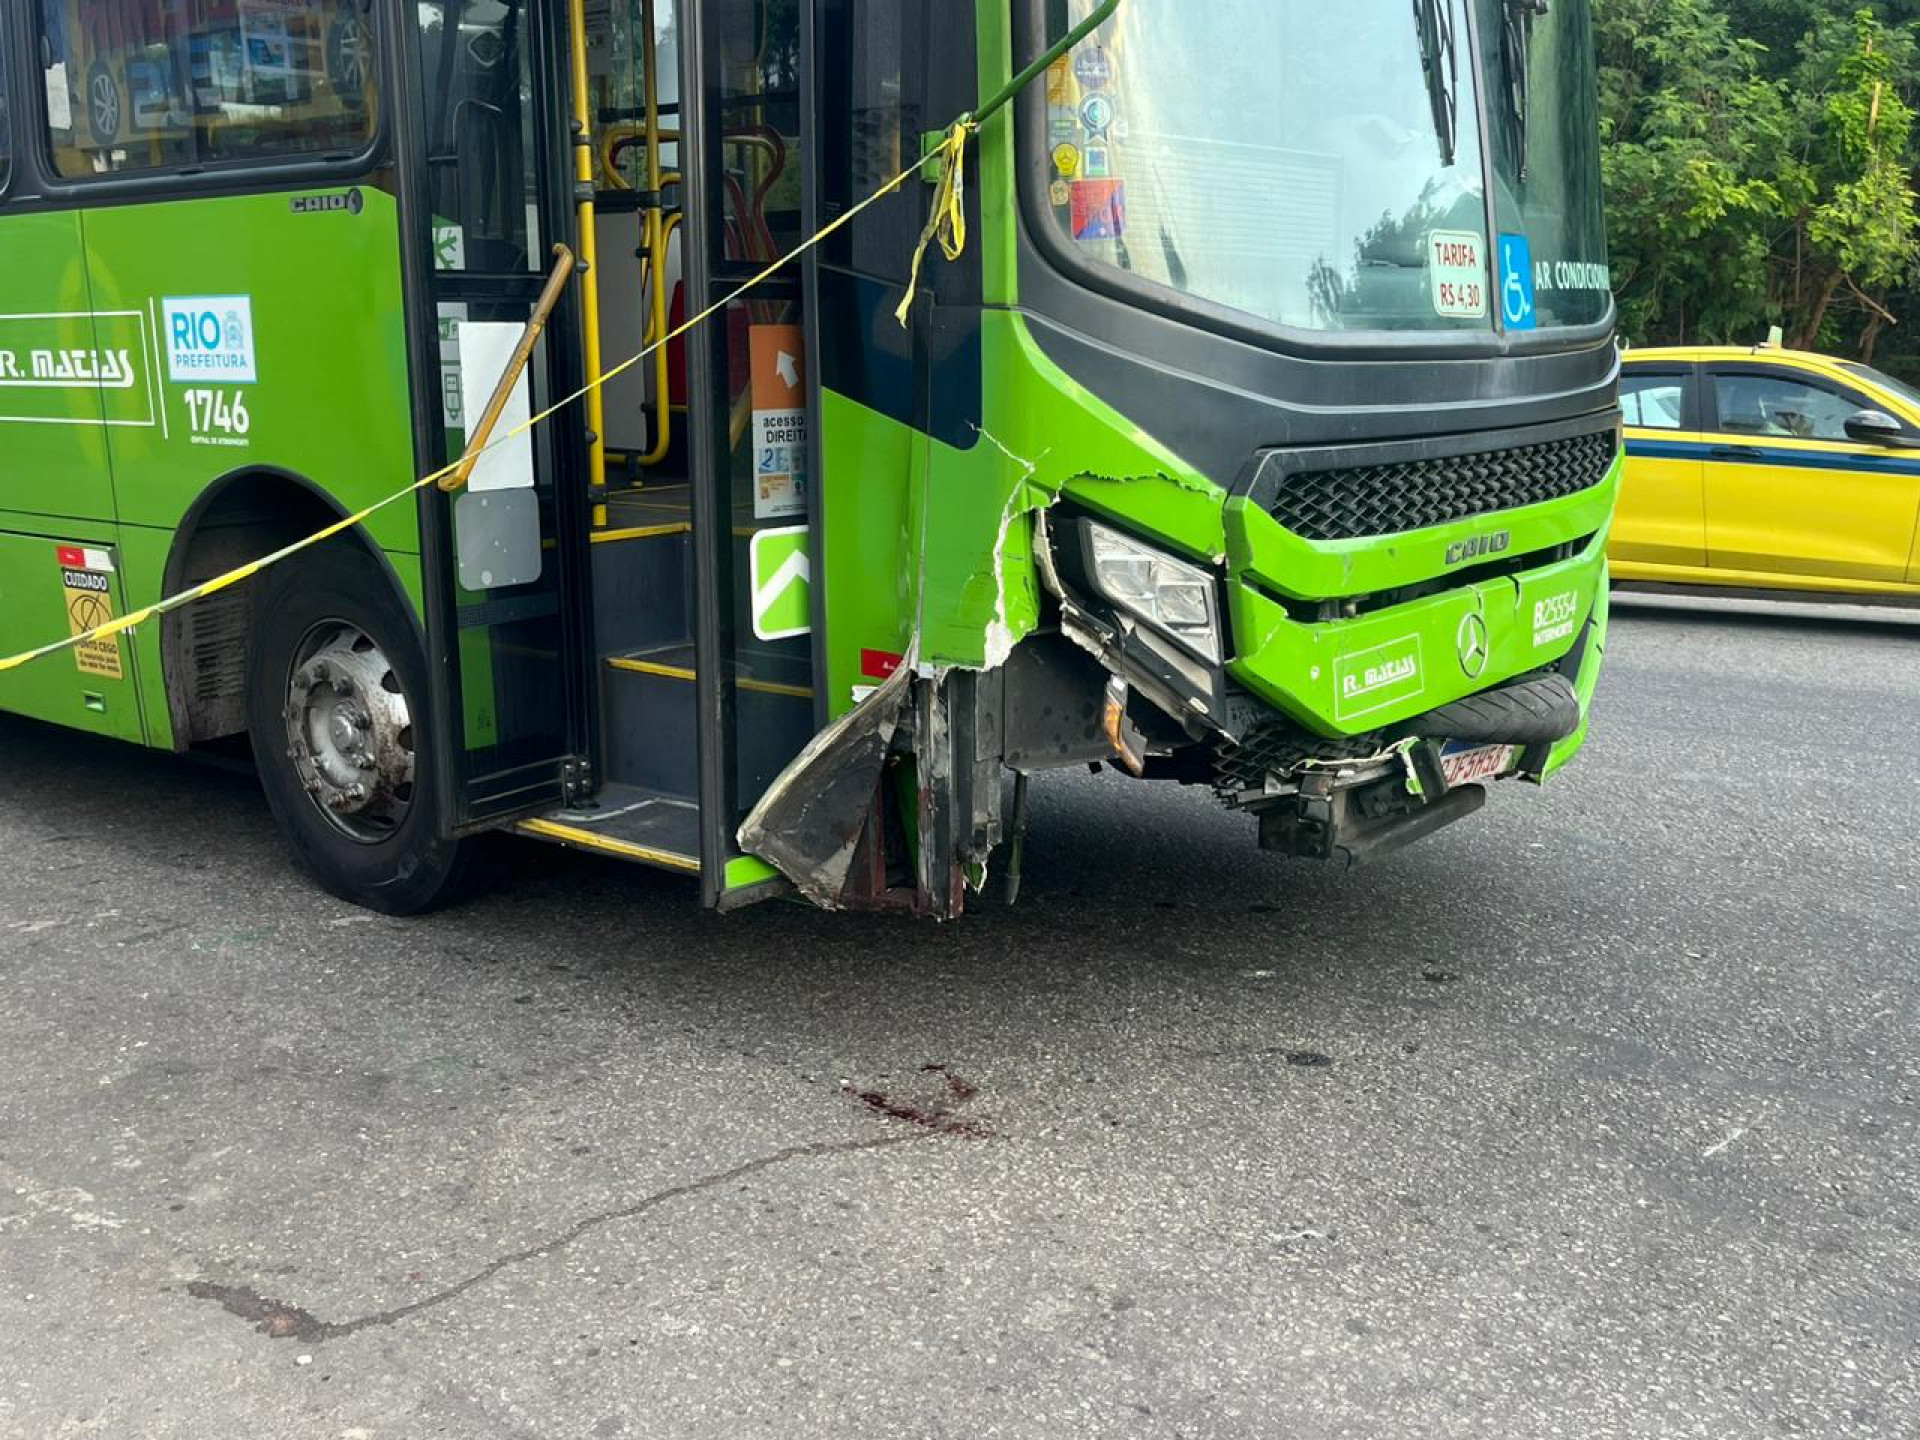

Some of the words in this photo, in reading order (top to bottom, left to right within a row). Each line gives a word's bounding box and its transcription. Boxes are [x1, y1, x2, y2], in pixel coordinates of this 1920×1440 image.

[1434, 242, 1477, 268] TARIFA
[1536, 261, 1553, 291] AR
[1458, 284, 1480, 309] 4,30
[172, 311, 221, 350] RIO
[175, 353, 248, 369] PREFEITURA
[184, 389, 250, 433] 1746
[763, 416, 804, 428] acesso
[1446, 531, 1509, 564] CAIO
[65, 571, 108, 591] CUIDADO
[1534, 590, 1578, 629] B25554
[1343, 674, 1362, 695] R.
